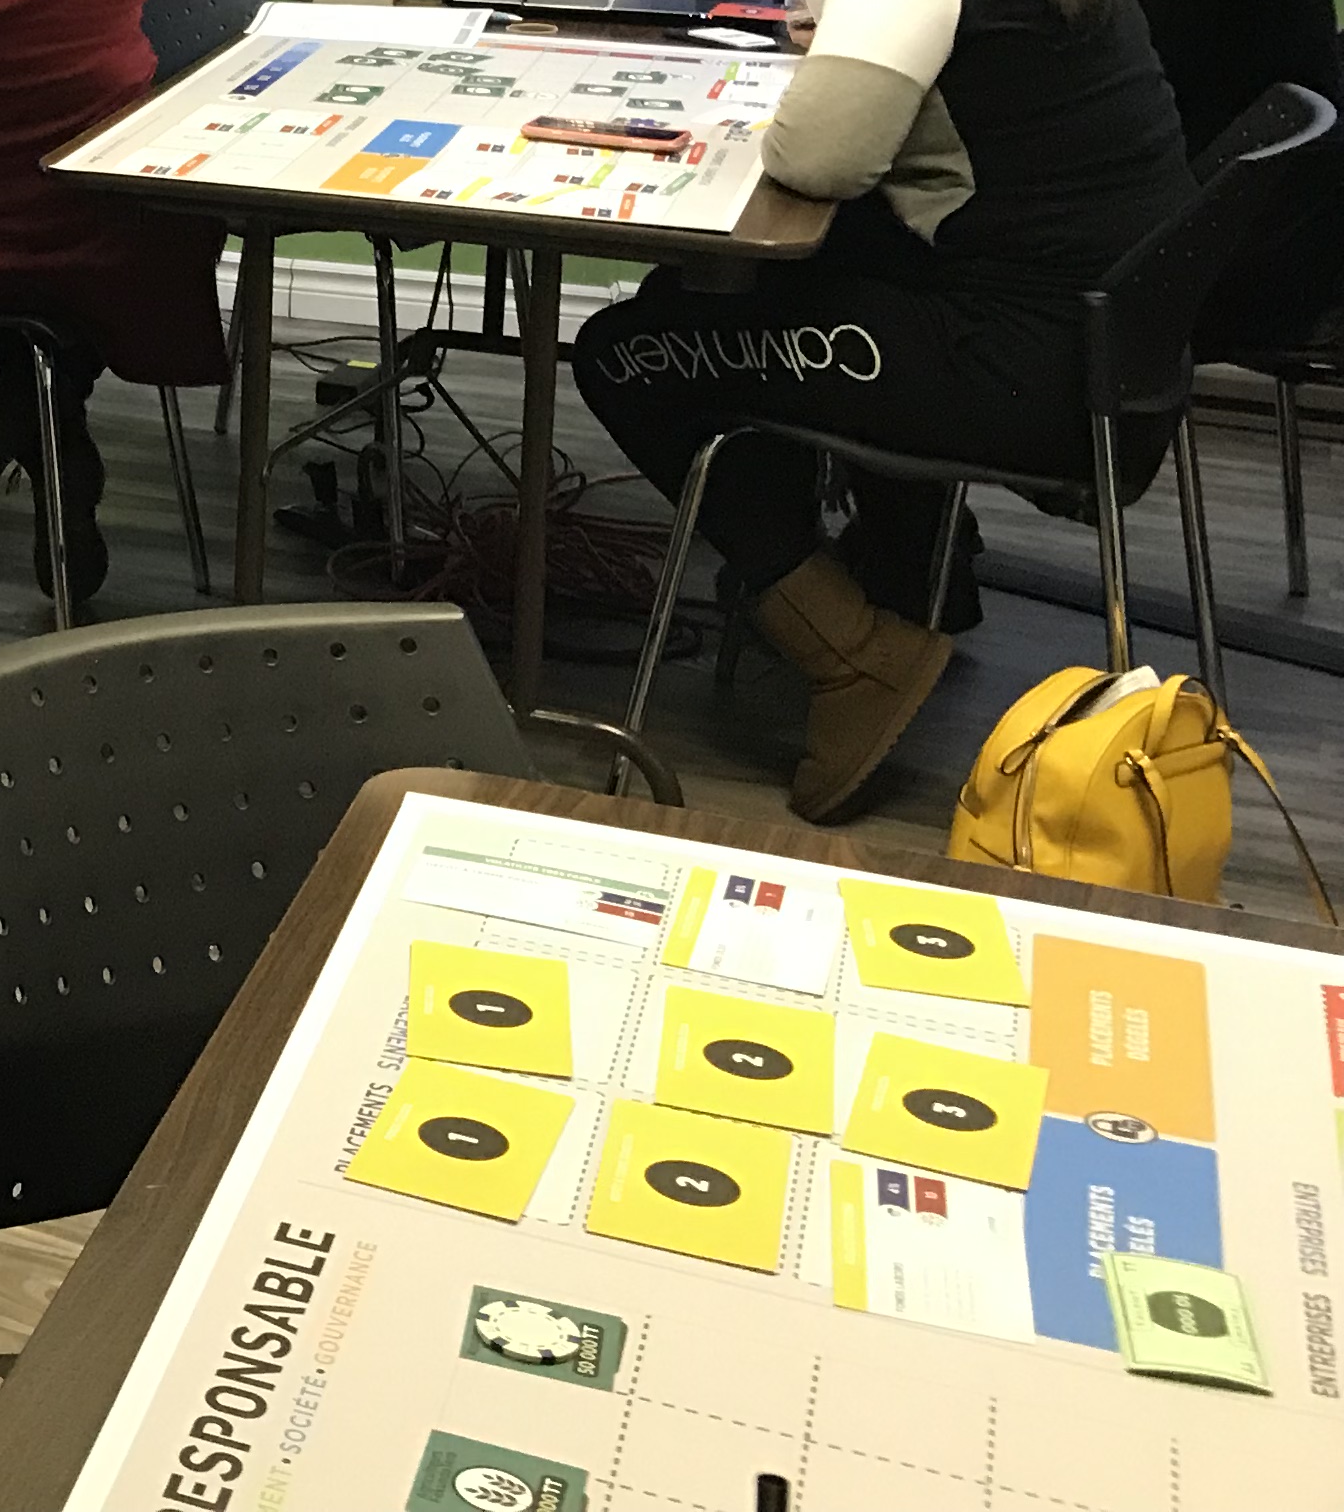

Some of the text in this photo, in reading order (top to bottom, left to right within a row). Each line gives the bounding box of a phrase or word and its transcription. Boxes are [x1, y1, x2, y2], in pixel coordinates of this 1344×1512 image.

[916, 935, 948, 948] 3
[476, 1003, 505, 1013] 1
[1089, 989, 1113, 1068] PLACEMENTS
[732, 1052, 765, 1067] 2
[932, 1101, 967, 1118] 3
[447, 1131, 480, 1145] 1
[675, 1175, 710, 1192] 2
[1123, 1216, 1155, 1254] ELÉS
[1291, 1180, 1329, 1278] ENTREPRISES
[279, 1375, 328, 1456] SOCIÉTÉ
[314, 1240, 379, 1366] GOUVERNANCE
[1302, 1291, 1340, 1399] ENTREPRISES
[156, 1221, 336, 1512] ESPONSABLE
